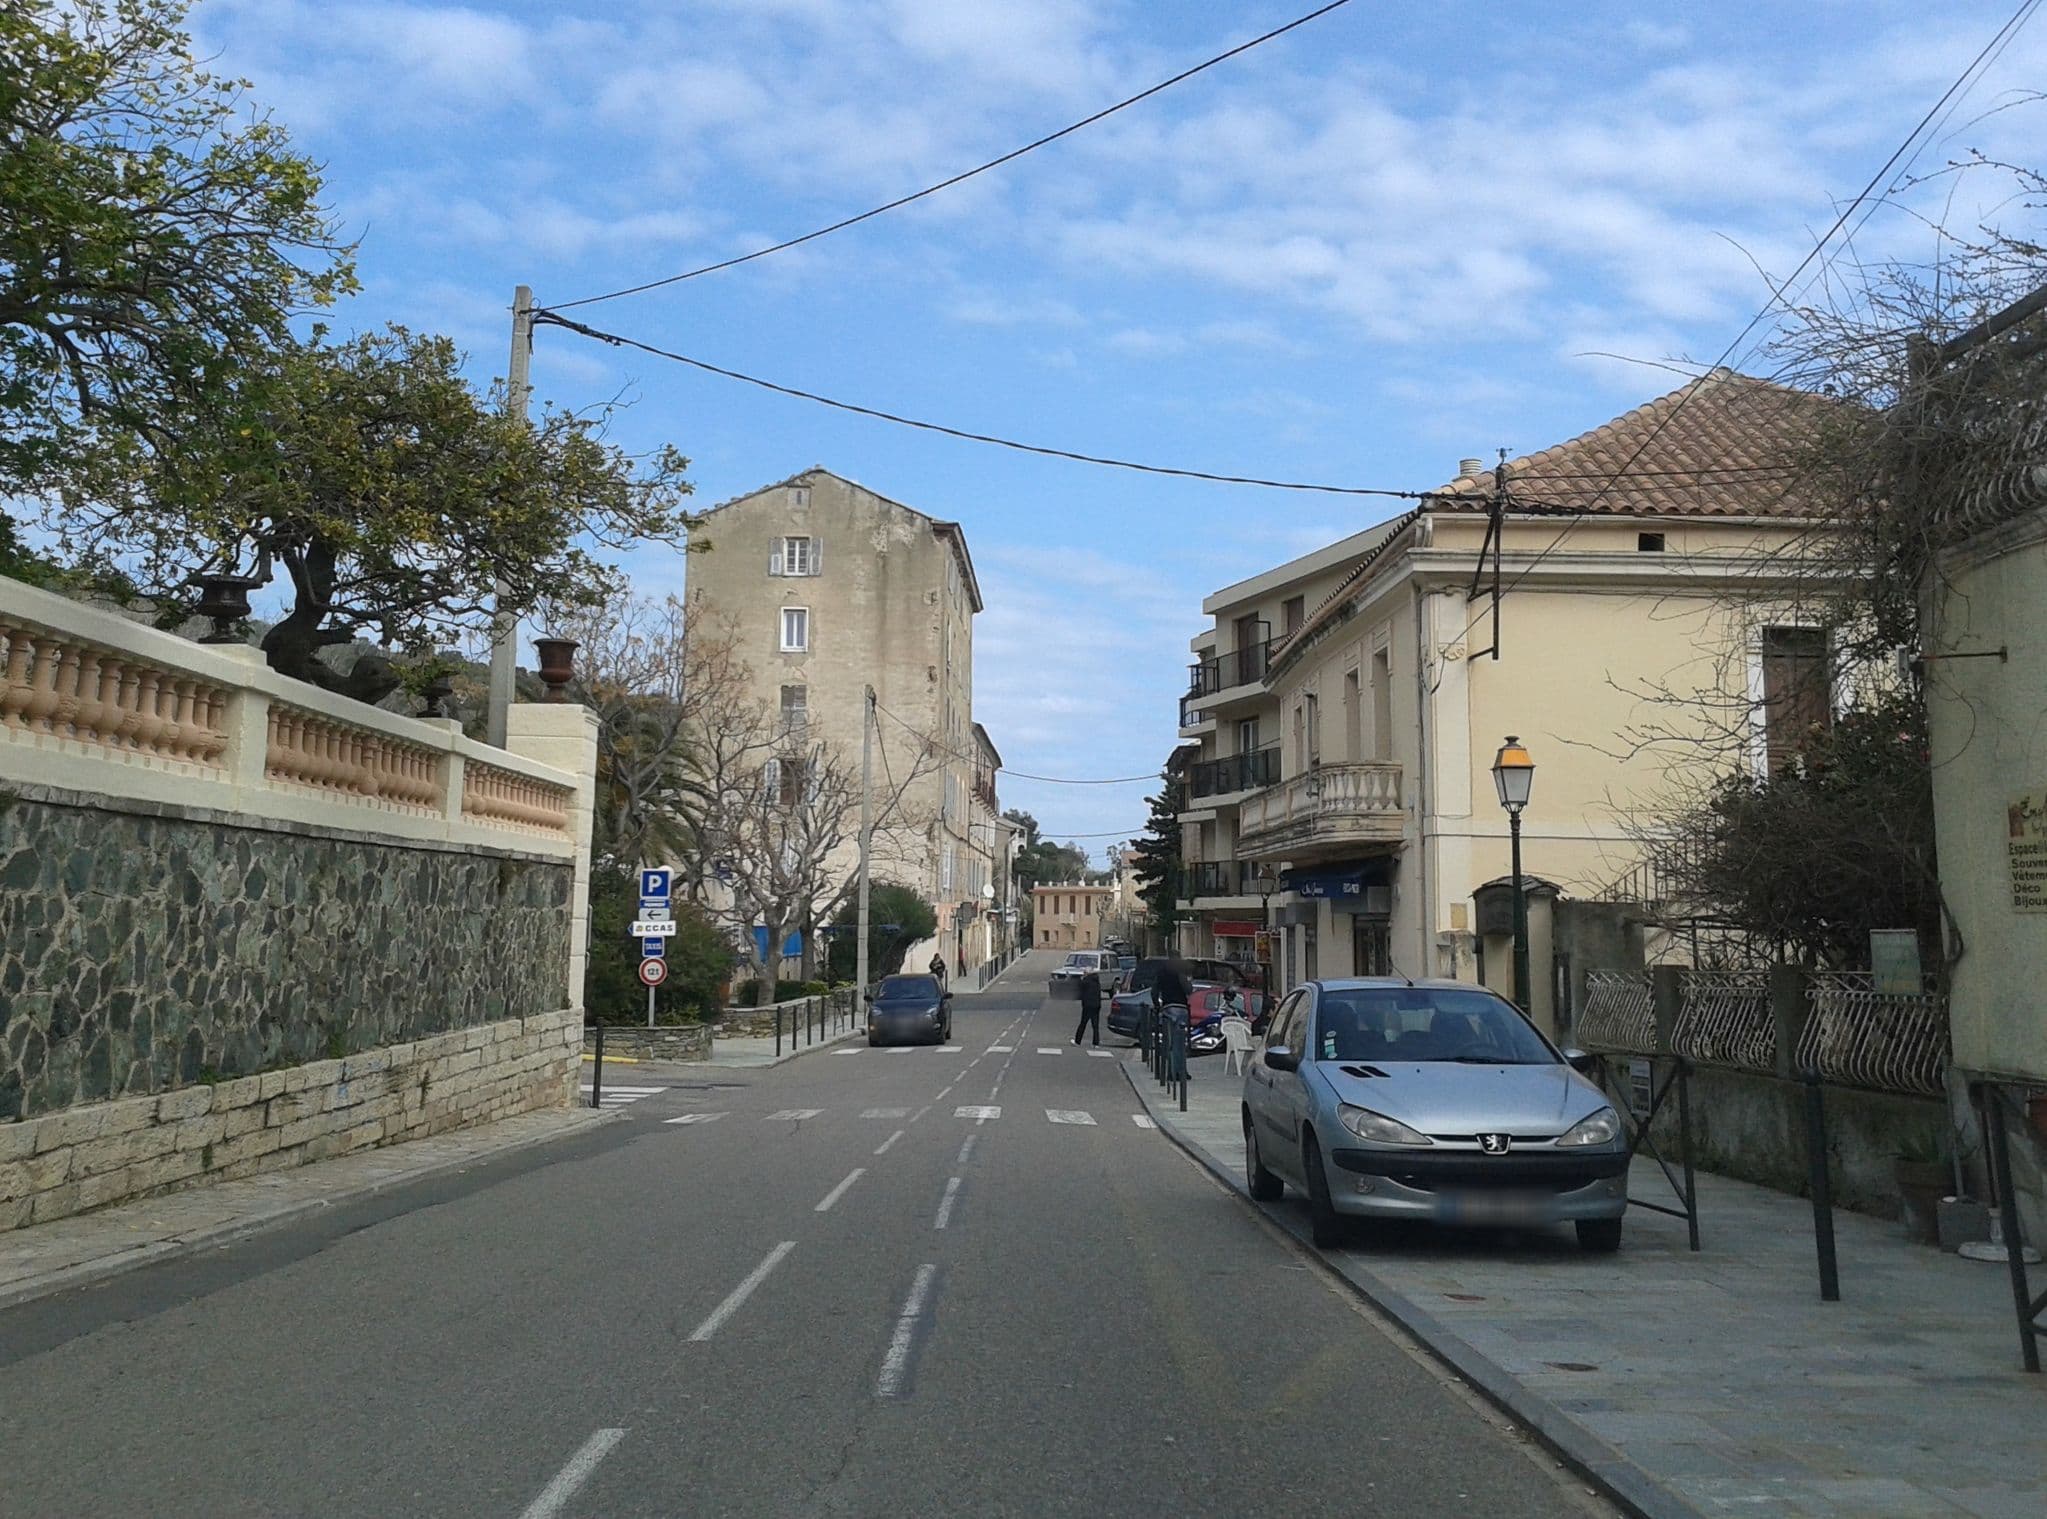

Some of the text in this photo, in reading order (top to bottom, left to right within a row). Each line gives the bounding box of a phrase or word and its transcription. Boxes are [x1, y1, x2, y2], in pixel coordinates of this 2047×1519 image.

[2012, 869, 2047, 881] Vêtem
[648, 875, 662, 893] P
[2013, 882, 2041, 894] Déco
